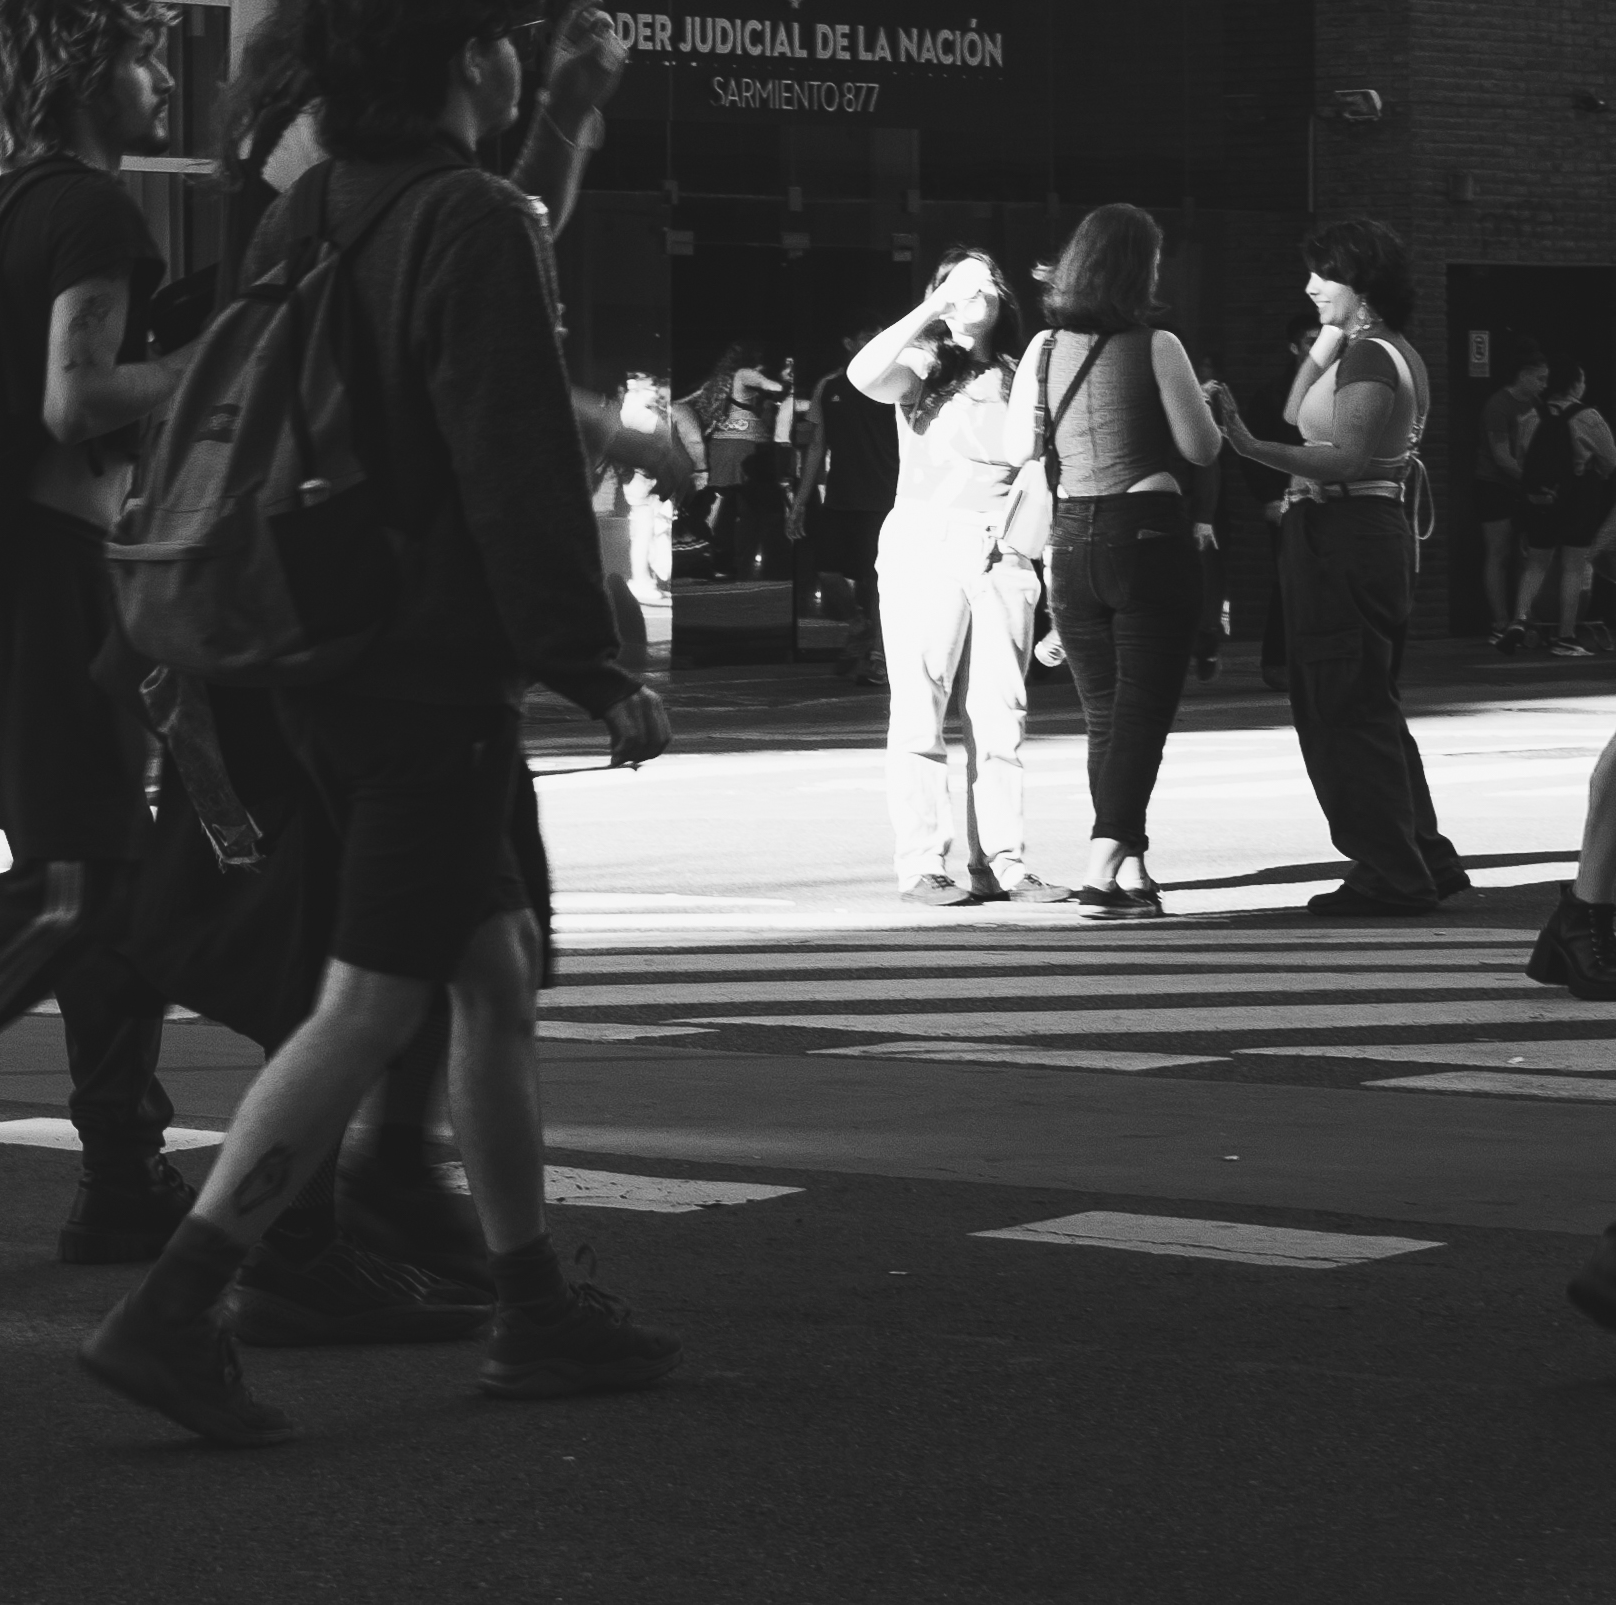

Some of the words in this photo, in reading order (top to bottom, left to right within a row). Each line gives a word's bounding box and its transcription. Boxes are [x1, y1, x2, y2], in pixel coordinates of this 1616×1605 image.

[614, 11, 673, 52] DER
[679, 15, 808, 59] JUDICIAL
[816, 23, 852, 62] DE
[857, 24, 892, 63] LA
[895, 17, 1004, 68] NACIÓN
[710, 76, 839, 112] SARMIENTO
[842, 81, 880, 113] 877
